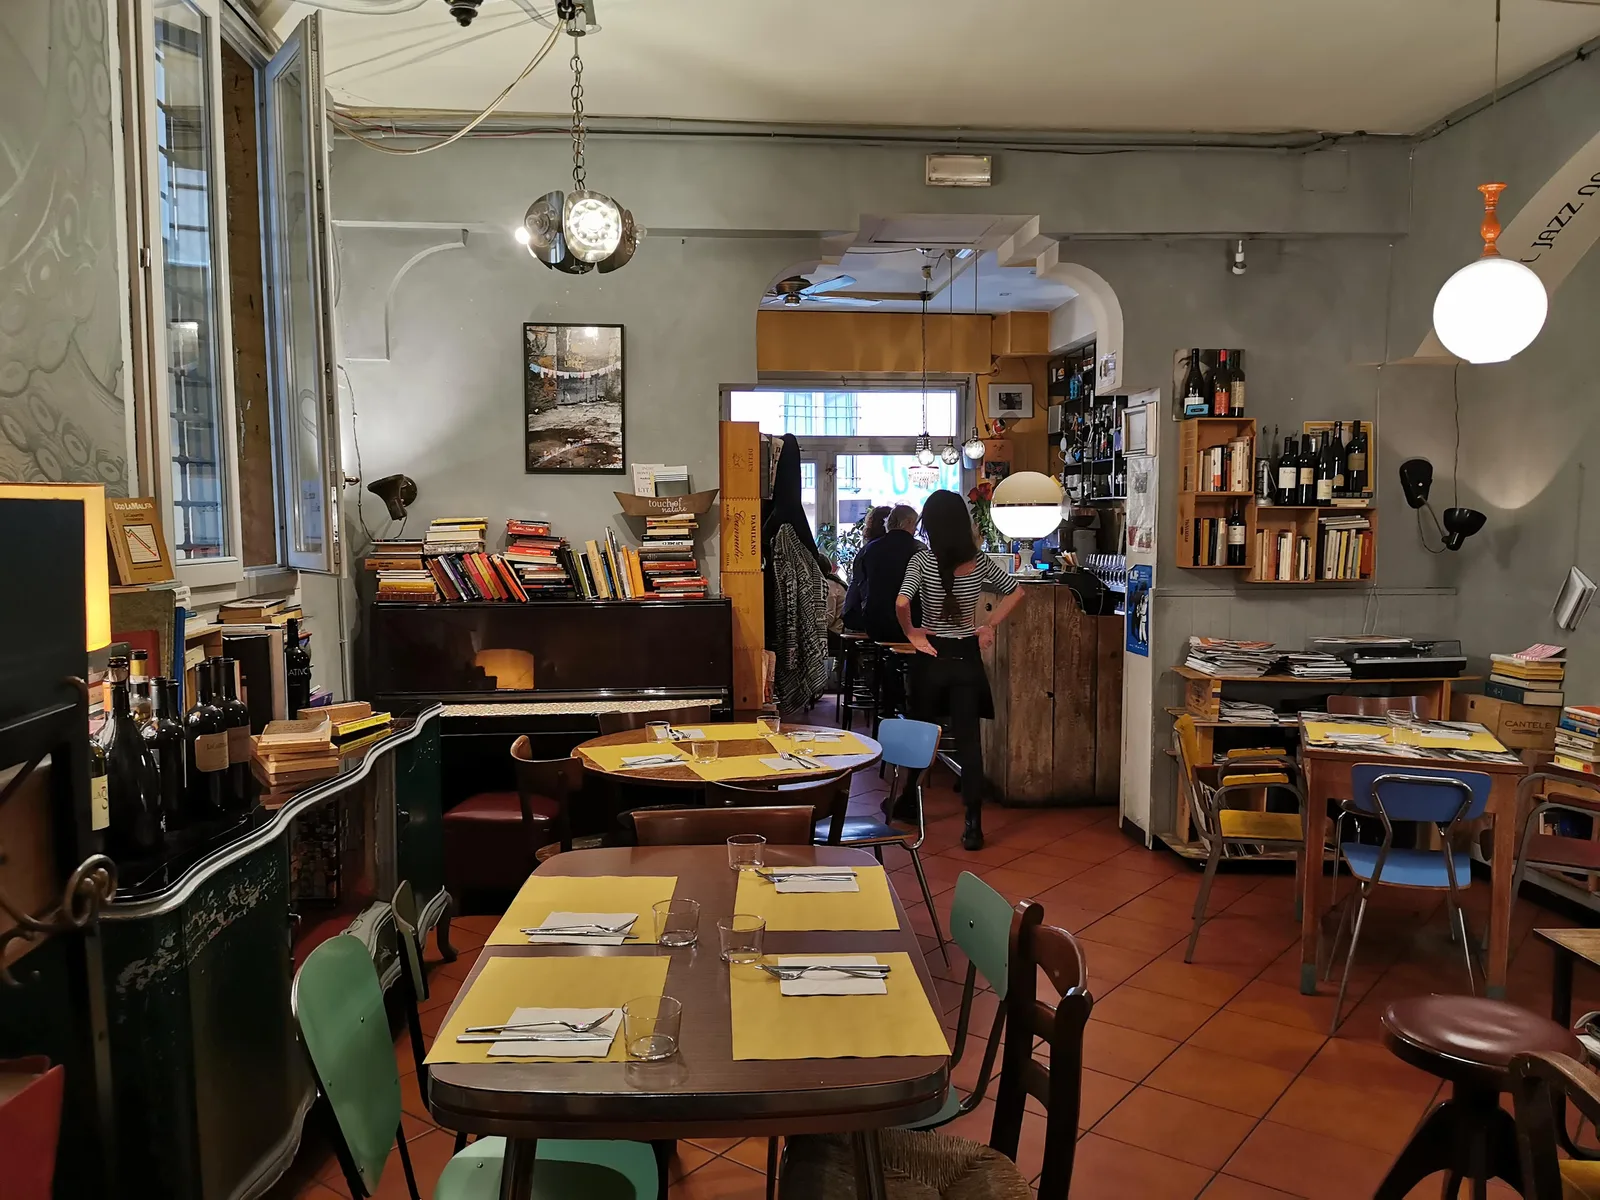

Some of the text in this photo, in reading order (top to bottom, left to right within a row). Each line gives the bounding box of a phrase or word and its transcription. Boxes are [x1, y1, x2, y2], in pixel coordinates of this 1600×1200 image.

[1531, 202, 1584, 250] JAZZ
[648, 498, 672, 508] touch
[1504, 720, 1553, 730] CANTELE
